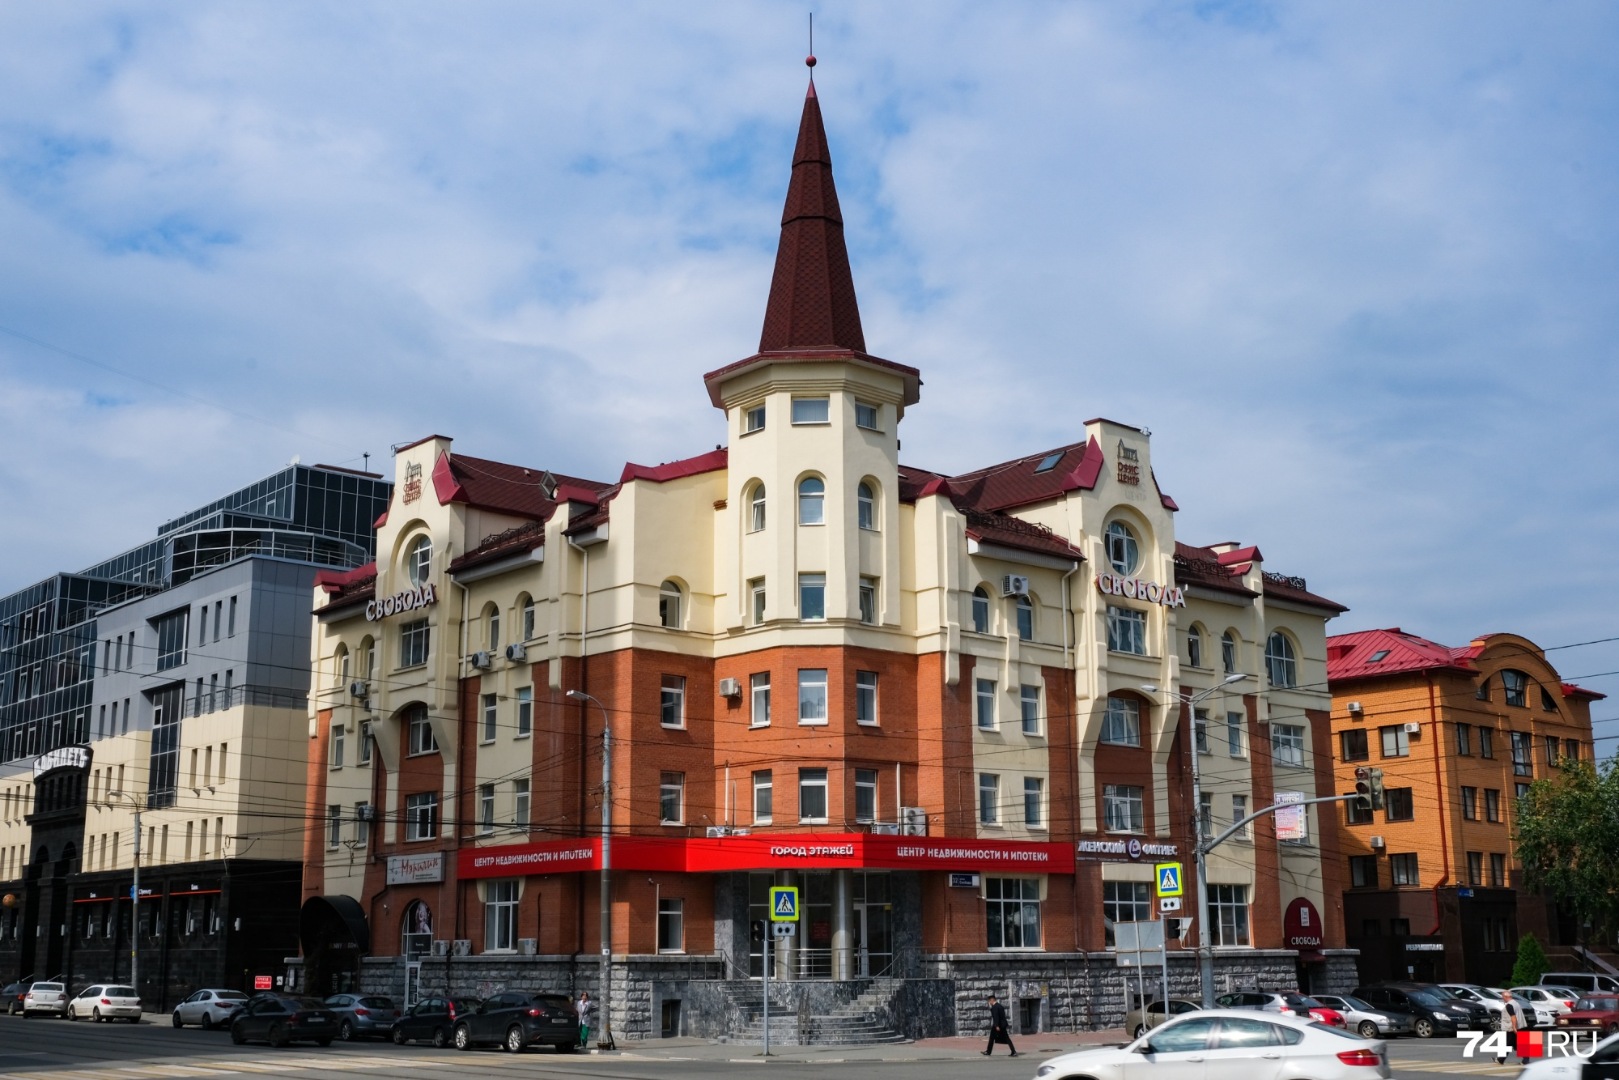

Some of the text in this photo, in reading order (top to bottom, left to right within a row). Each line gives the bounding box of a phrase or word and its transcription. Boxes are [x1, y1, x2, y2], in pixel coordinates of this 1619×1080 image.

[1097, 572, 1186, 608] СВОБОДА
[366, 583, 437, 622] СВОБОДА
[770, 844, 854, 856] ГОРОД ЭТАЖЕЙ
[897, 847, 1048, 861] ЦЕНТР НЕДВИЖИМОСТИ И ИПОТЕКИ
[1078, 840, 1178, 855] ЖЕНСКИЙ ФИТНЕС
[474, 849, 592, 867] ЦЕНТР НЕДВИЖИМОСТИ И ИПОТЕКИ
[1291, 936, 1321, 946] СВОБОДА
